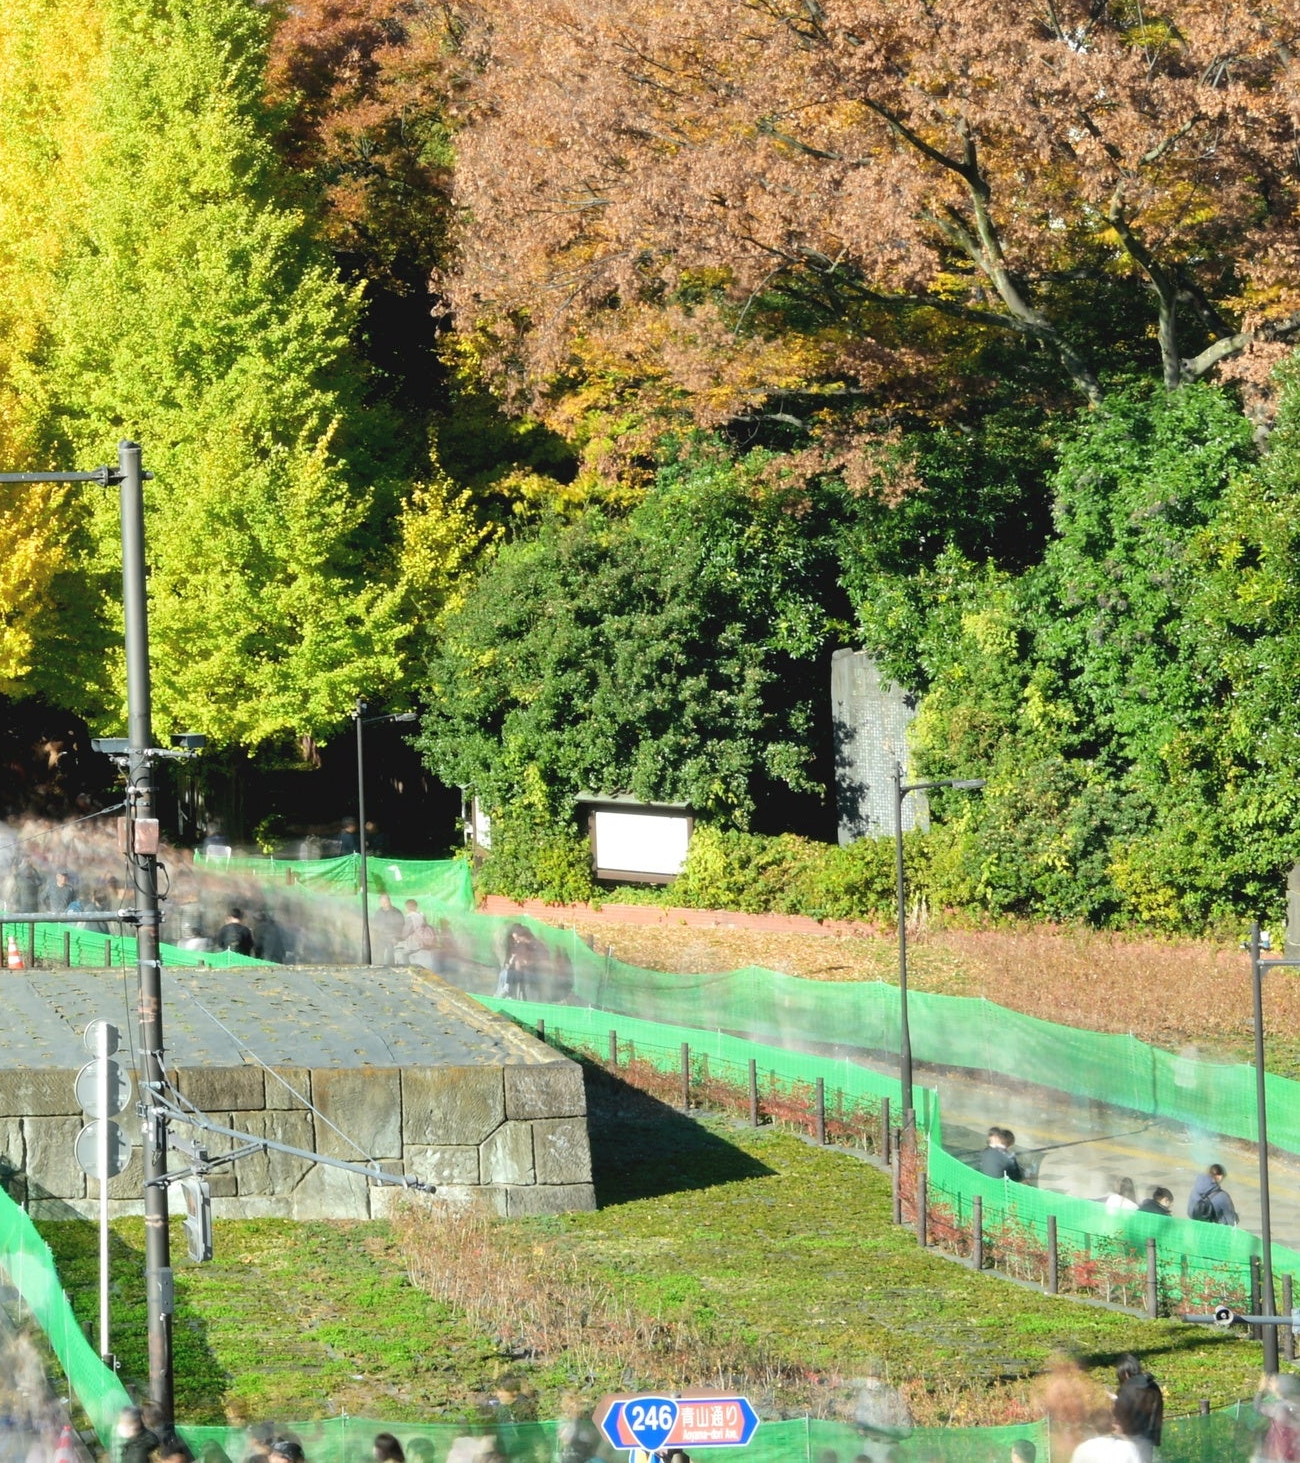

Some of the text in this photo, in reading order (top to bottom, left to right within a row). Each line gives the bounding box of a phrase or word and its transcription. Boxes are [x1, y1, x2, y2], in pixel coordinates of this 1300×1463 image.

[631, 1404, 673, 1431] 246
[681, 1405, 738, 1428] 青山通り
